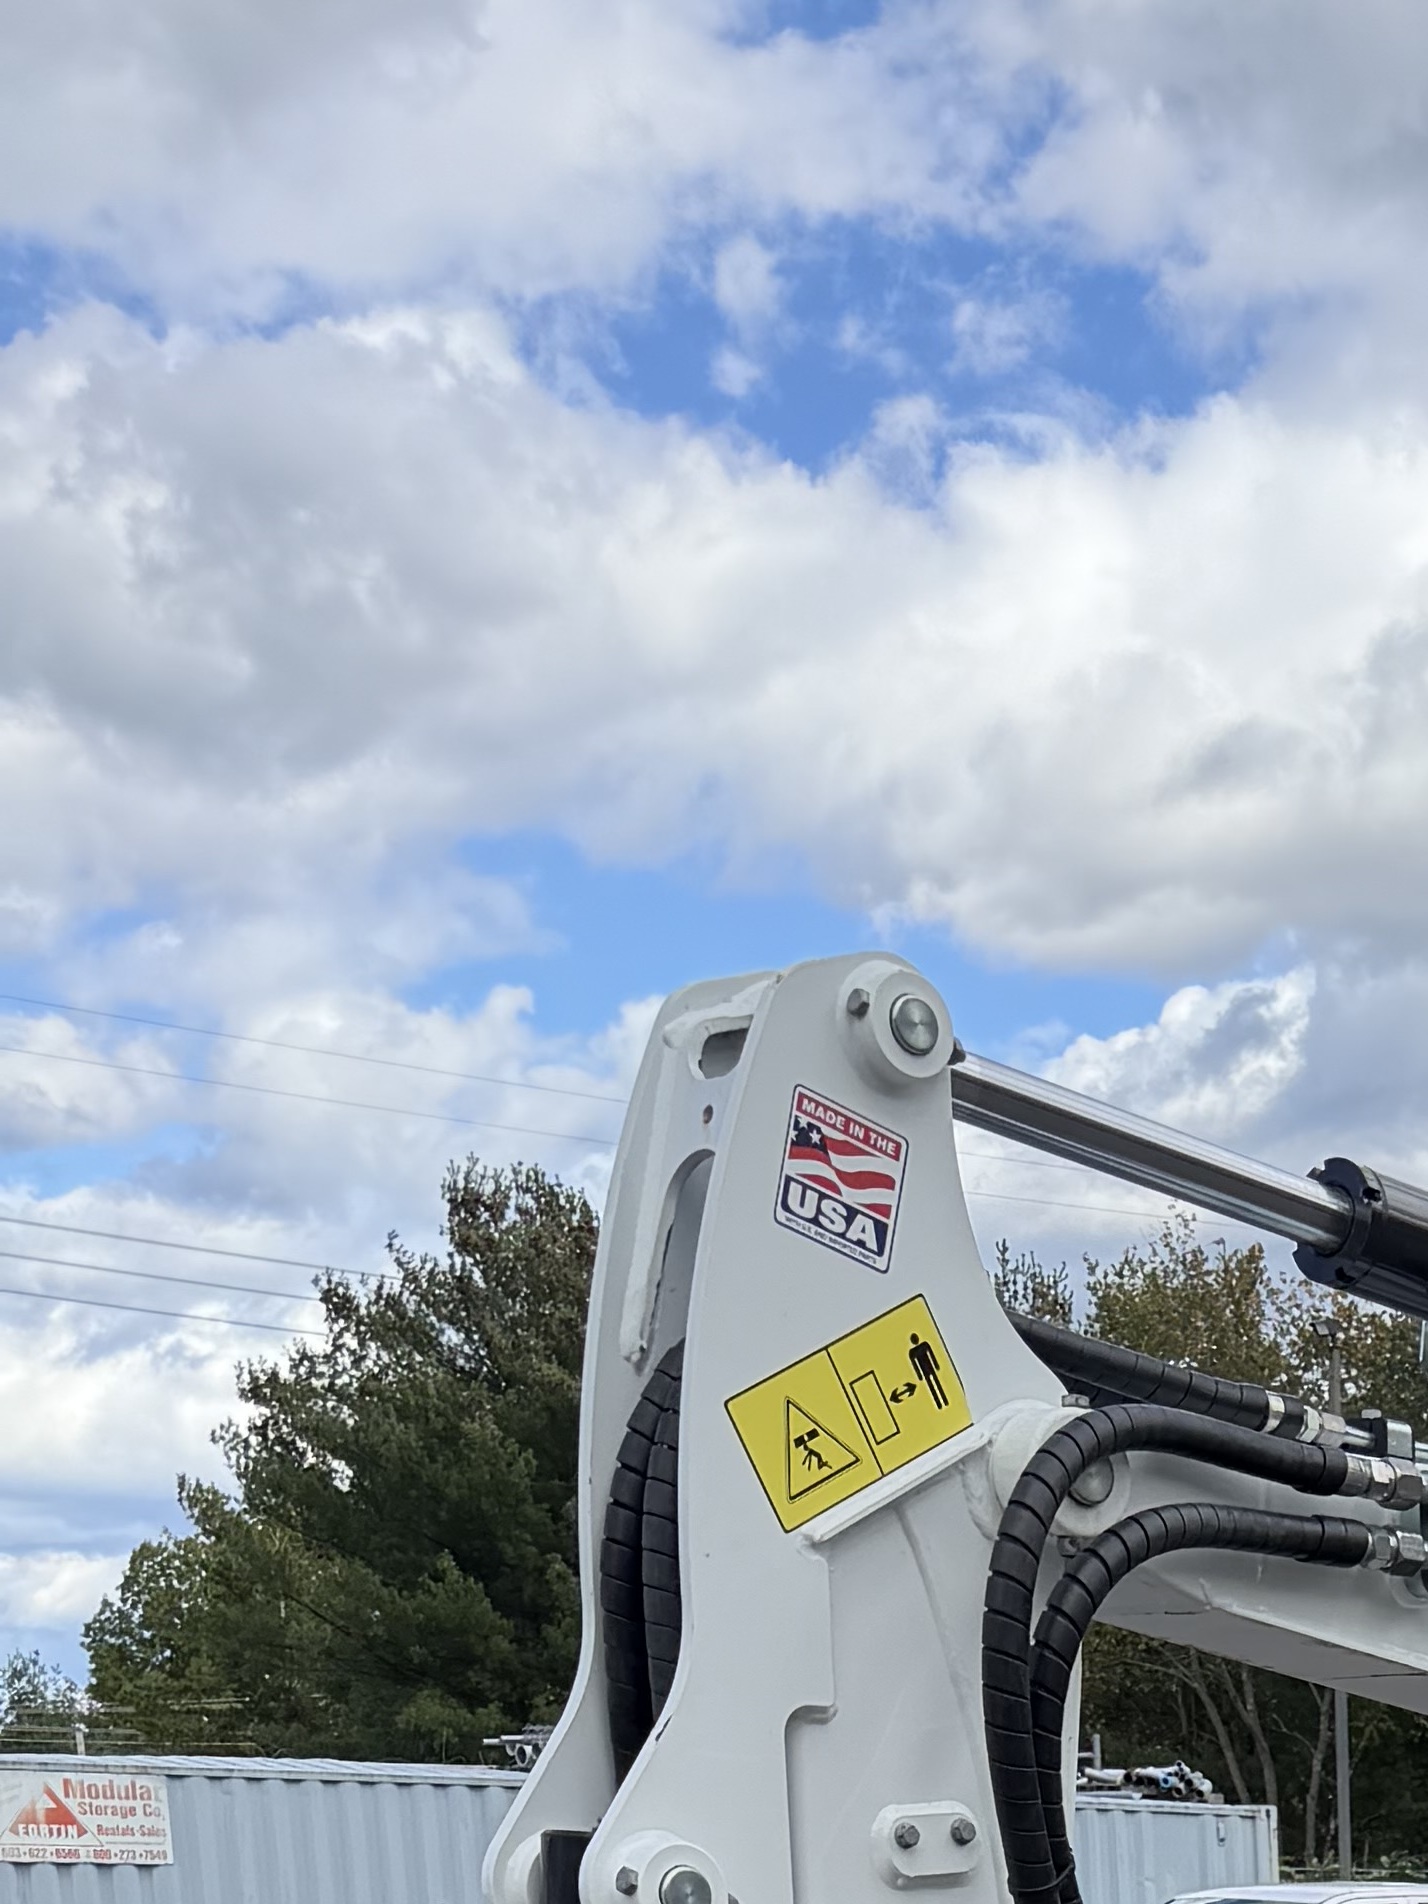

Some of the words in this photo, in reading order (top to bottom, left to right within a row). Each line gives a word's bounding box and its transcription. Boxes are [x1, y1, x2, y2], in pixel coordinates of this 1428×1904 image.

[801, 1098, 845, 1129] MADE
[849, 1122, 865, 1139] IN
[869, 1131, 897, 1156] THE
[787, 1181, 878, 1253] USA
[62, 1778, 165, 1803] Modular
[77, 1801, 137, 1819] Storage
[17, 1824, 78, 1840] FORTIN
